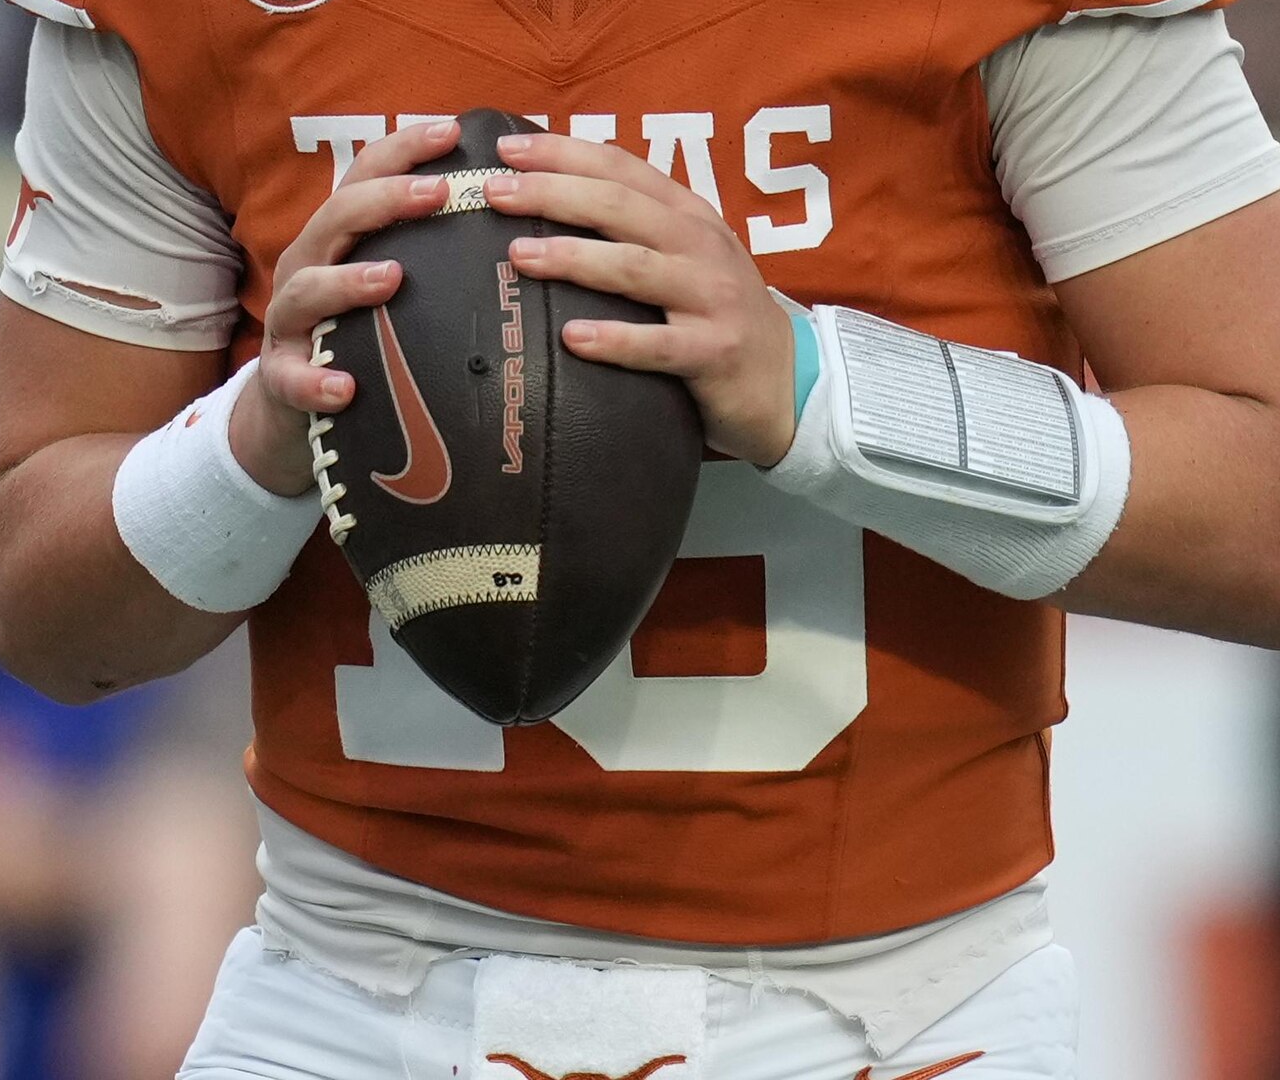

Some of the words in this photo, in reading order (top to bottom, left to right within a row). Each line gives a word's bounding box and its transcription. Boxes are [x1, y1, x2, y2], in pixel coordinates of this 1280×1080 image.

[290, 104, 833, 255] TAS
[496, 261, 524, 353] ELITE
[502, 355, 524, 474] VAPOR
